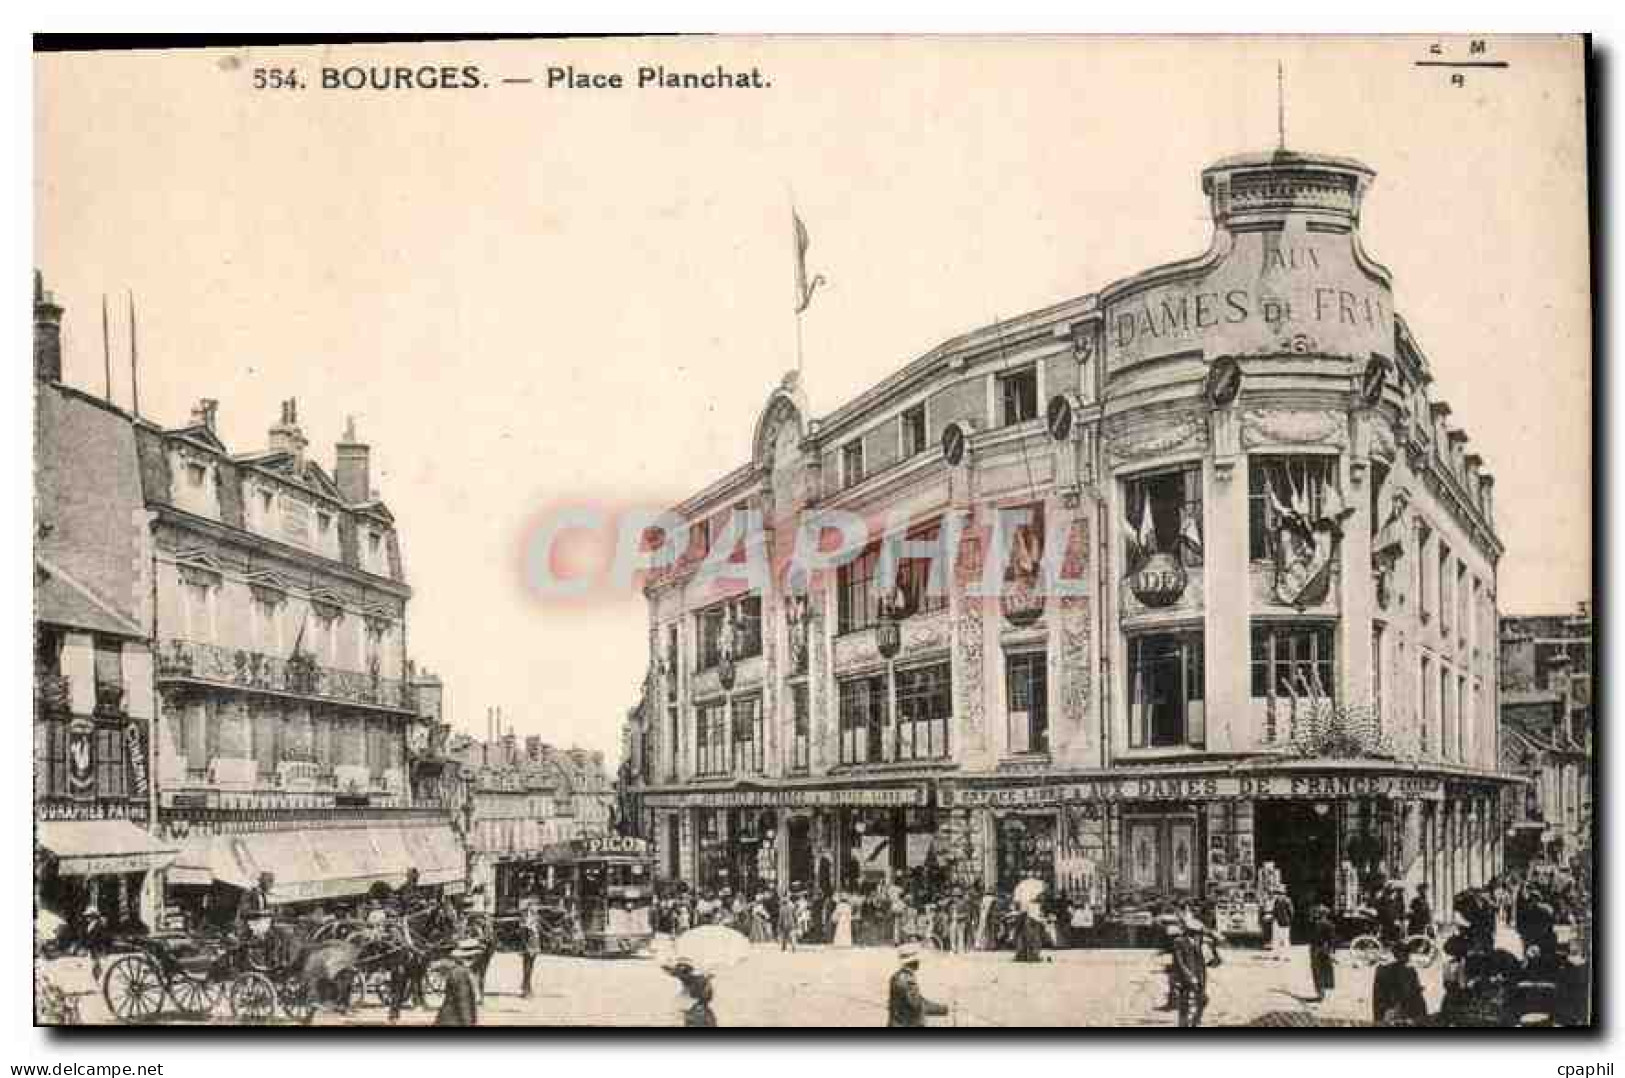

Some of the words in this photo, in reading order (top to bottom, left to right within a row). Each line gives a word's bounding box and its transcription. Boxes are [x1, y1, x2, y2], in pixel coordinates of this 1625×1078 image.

[1113, 289, 1249, 349] DAMES
[1139, 778, 1217, 799] DAMES
[1238, 777, 1270, 796] DE
[1291, 777, 1380, 796] FRANCE
